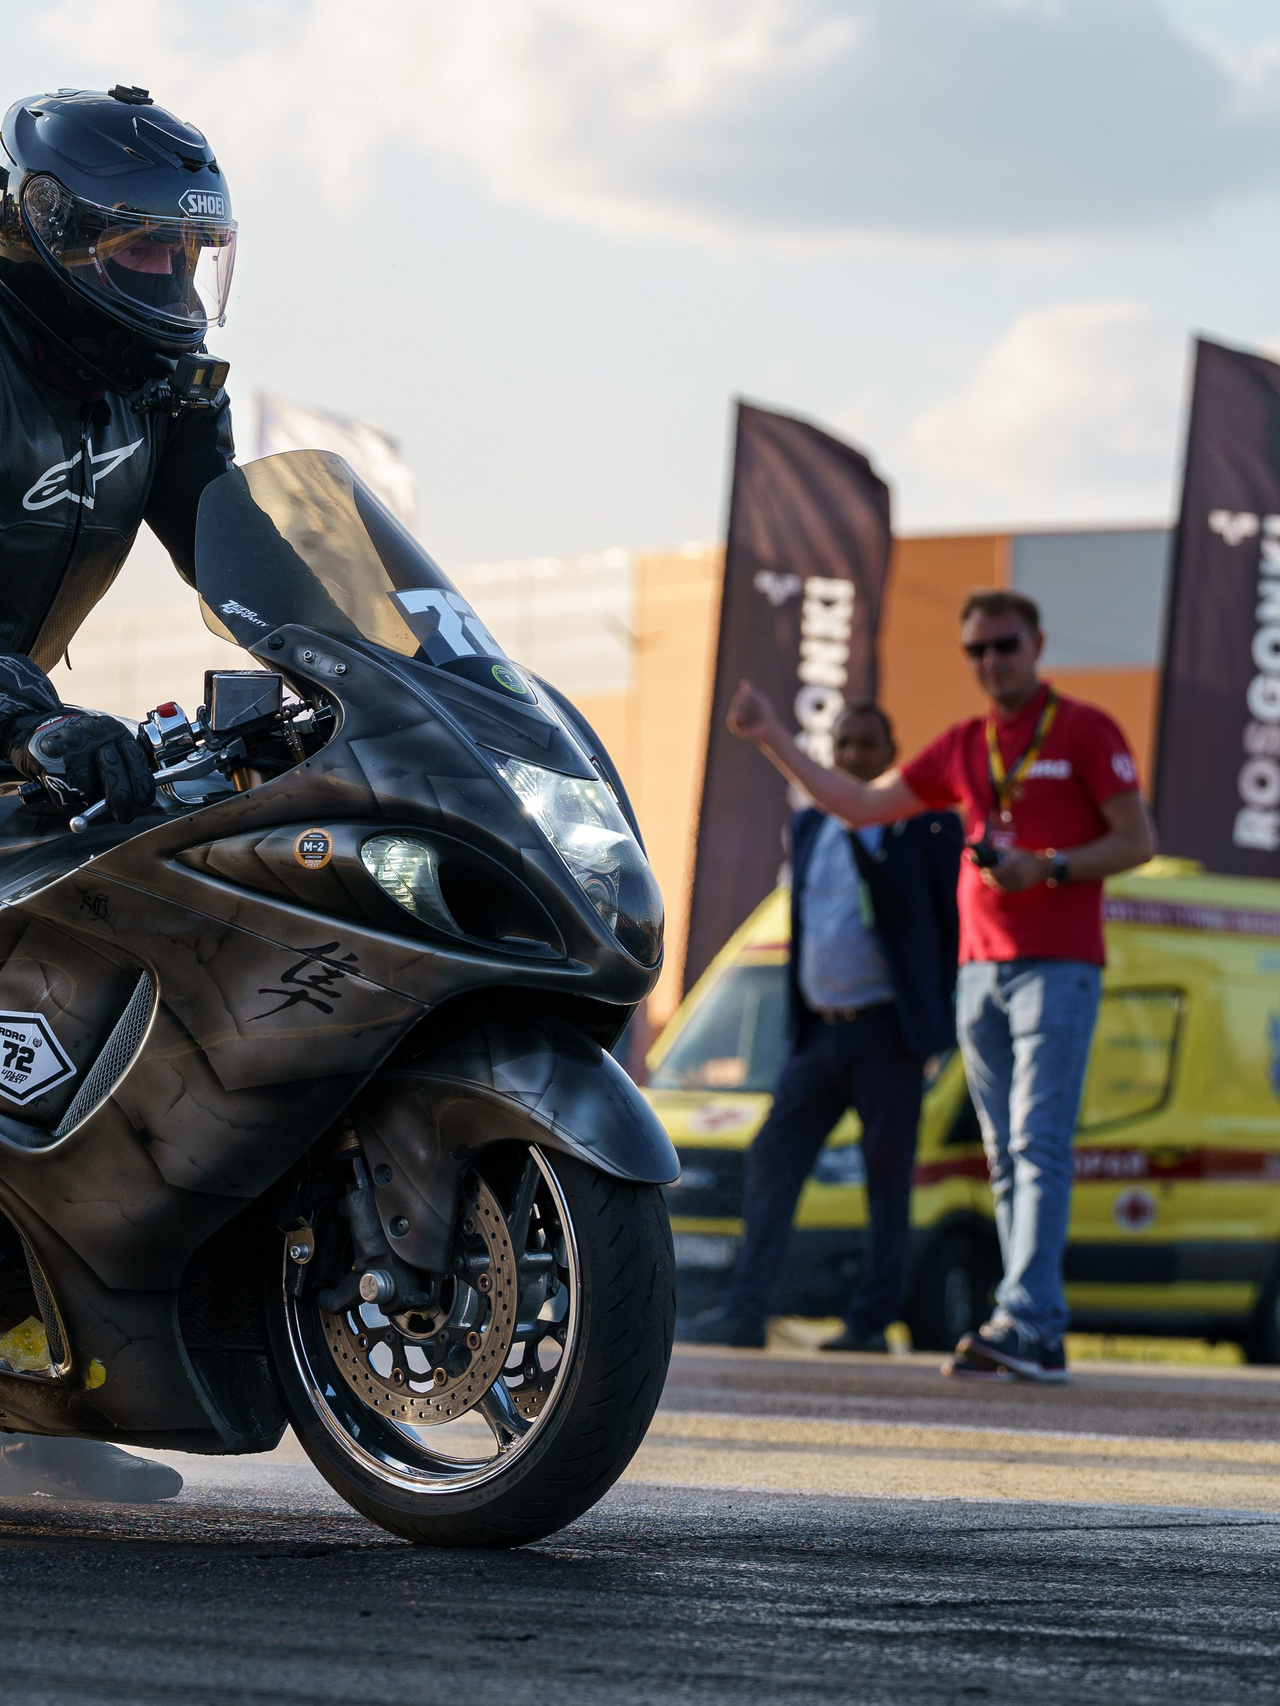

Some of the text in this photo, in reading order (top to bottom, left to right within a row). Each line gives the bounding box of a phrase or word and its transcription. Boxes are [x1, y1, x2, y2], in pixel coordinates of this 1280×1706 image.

[187, 194, 225, 216] SHOEI
[221, 599, 258, 617] ZERO
[303, 841, 325, 852] M-2
[3, 1040, 36, 1074] 72
